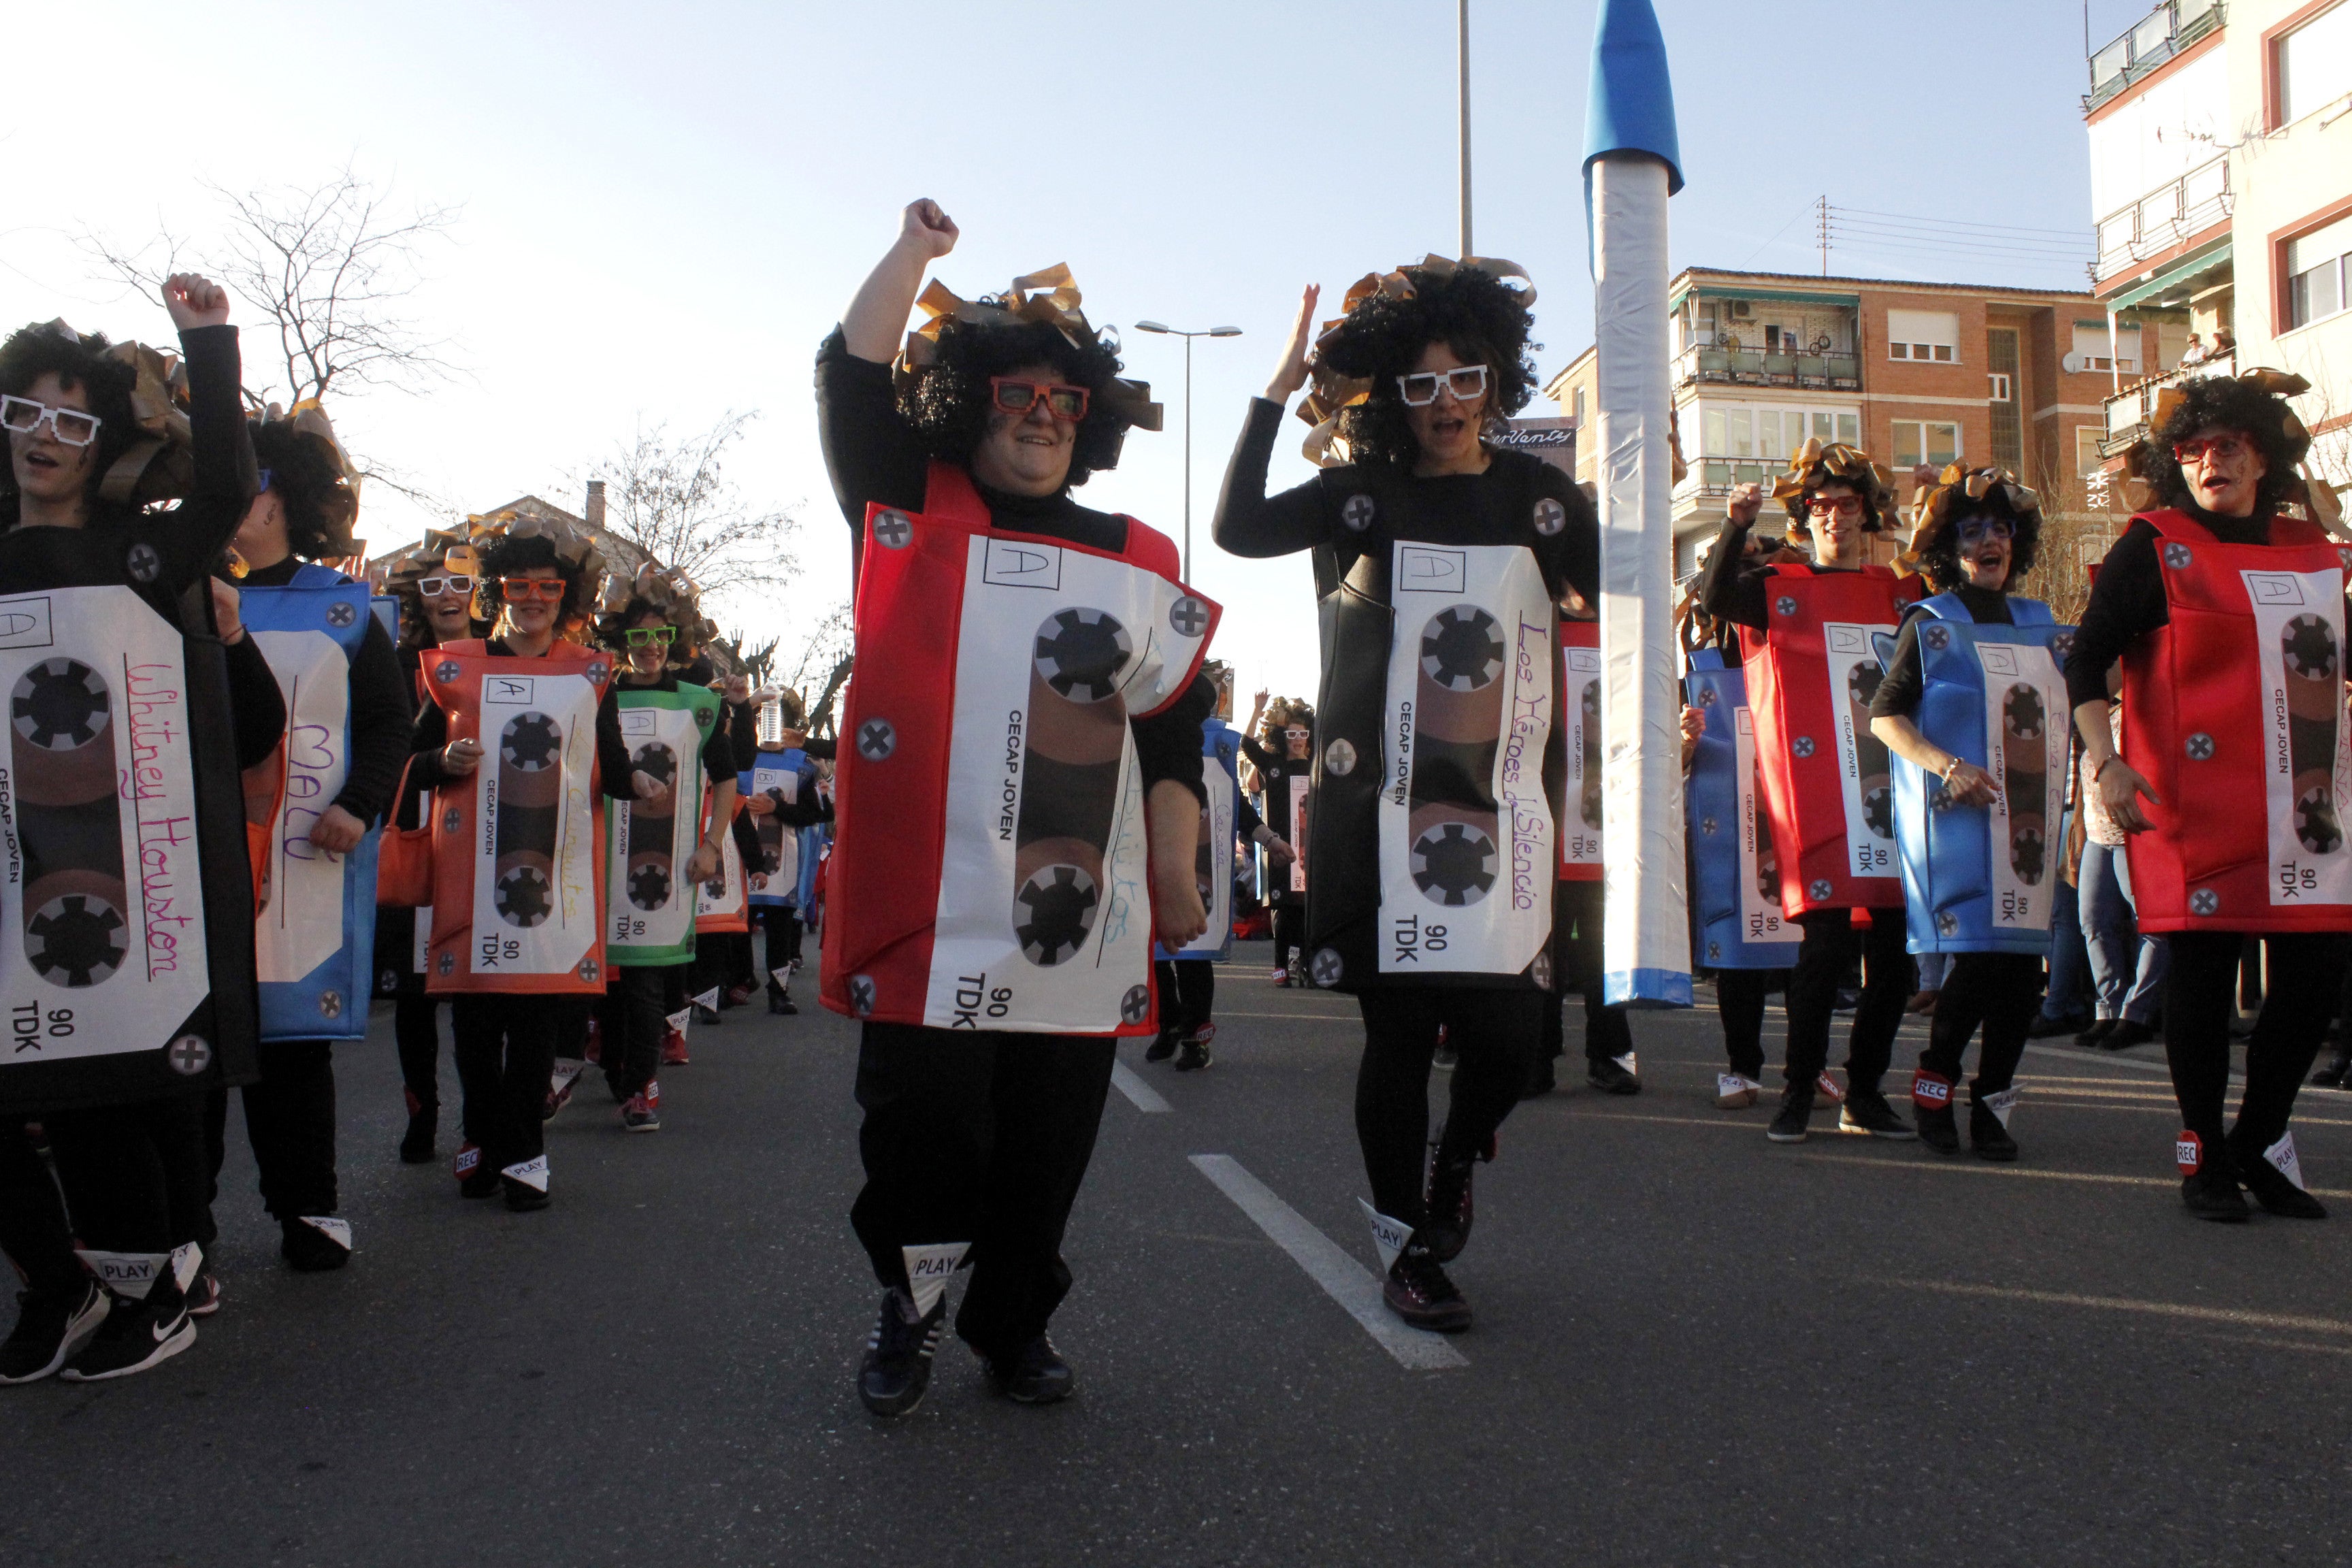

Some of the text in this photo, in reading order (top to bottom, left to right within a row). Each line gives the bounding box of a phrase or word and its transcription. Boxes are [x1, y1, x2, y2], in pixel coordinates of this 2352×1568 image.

[997, 548, 1049, 574] A
[1411, 555, 1455, 577] A
[2260, 581, 2291, 596] A
[1518, 622, 1547, 683] Los
[1836, 632, 1859, 647] A
[1987, 653, 2009, 668] A
[496, 681, 525, 698] A
[627, 717, 651, 730] A
[2274, 689, 2289, 774] CECAP JOVEN
[1394, 701, 1411, 806] CECAP JOVEN
[1843, 715, 1857, 778] CECAP JOVEN
[999, 709, 1022, 841] CECAP JOVEN
[1995, 746, 2003, 781] CECAP
[119, 664, 190, 978] Whitney Houston
[485, 779, 495, 855] CECAP JOVEN
[5, 829, 20, 883] JOVEN
[1573, 834, 1583, 859] TDK
[1586, 840, 1597, 853] 90
[1858, 843, 1872, 872] TDK
[1875, 849, 1888, 866] 90
[1514, 812, 1546, 910] Silencio
[2280, 860, 2299, 898] TDK
[2300, 868, 2317, 890] 90
[2002, 889, 2016, 921] TDK
[2018, 896, 2027, 915] 90
[616, 914, 630, 941] TDK
[633, 920, 645, 936] 90
[1424, 924, 1447, 951] 90
[1750, 911, 1764, 938] TDK
[1767, 917, 1779, 932] 90
[481, 932, 499, 967] TDK
[502, 940, 520, 960] 90
[1394, 914, 1418, 963] TDK
[952, 972, 985, 1030] TDK
[987, 987, 1013, 1018] 90
[12, 1000, 42, 1054] TDK
[48, 1009, 75, 1038] 90
[1197, 1028, 1213, 1041] REC
[1917, 1081, 1947, 1097] REC
[457, 1152, 478, 1170] REC
[2178, 1145, 2195, 1162] REC
[2276, 1146, 2296, 1169] PLAY
[513, 1161, 544, 1175] PLAY
[1371, 1219, 1399, 1246] PLAY
[104, 1264, 149, 1278] PLAY
[915, 1256, 957, 1275] PLAY
